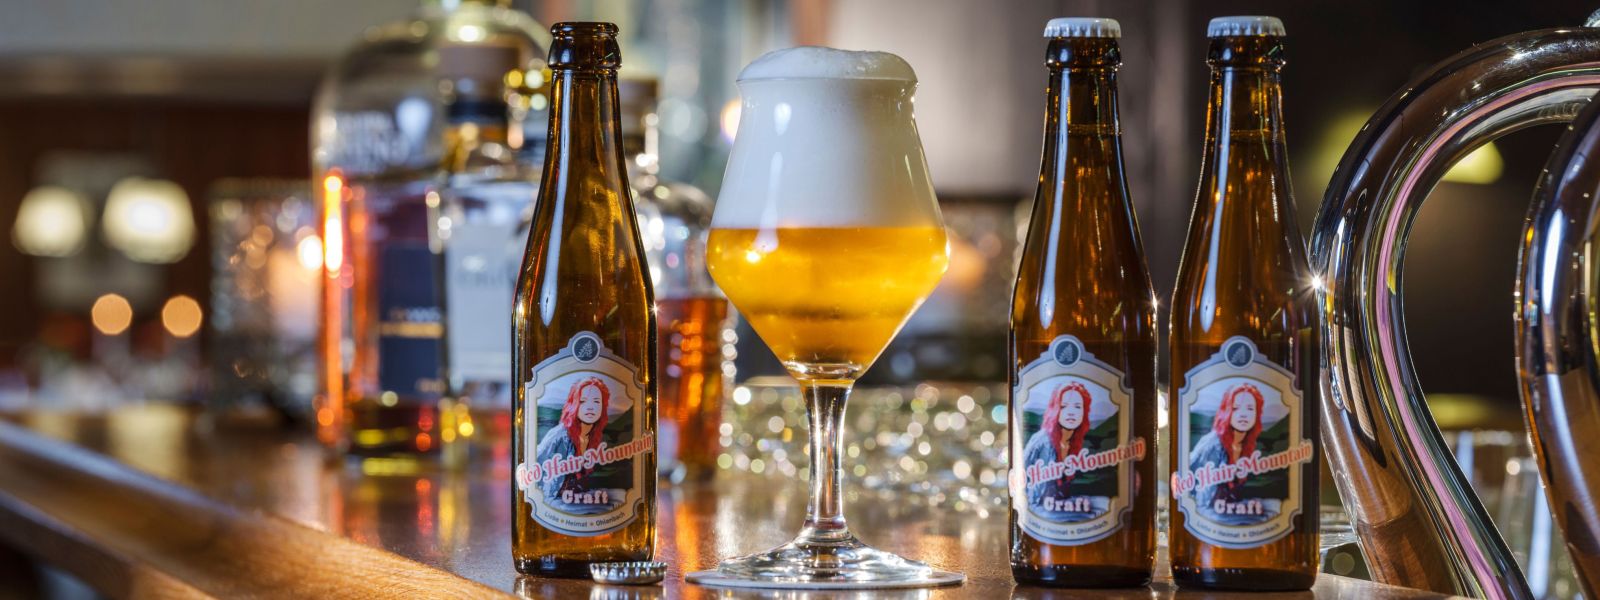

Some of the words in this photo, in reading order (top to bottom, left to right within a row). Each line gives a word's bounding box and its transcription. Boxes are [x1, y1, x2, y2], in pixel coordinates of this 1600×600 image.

[518, 463, 541, 488] Red
[543, 454, 583, 480] Hair
[584, 433, 653, 467] Mountain
[1027, 460, 1064, 485] Hair
[1065, 440, 1145, 473] Mountain
[1196, 463, 1236, 489] Hair
[1238, 442, 1312, 476] Mountain
[562, 490, 608, 504] Craft
[1044, 497, 1091, 512] Craft
[1214, 500, 1263, 515] Craft
